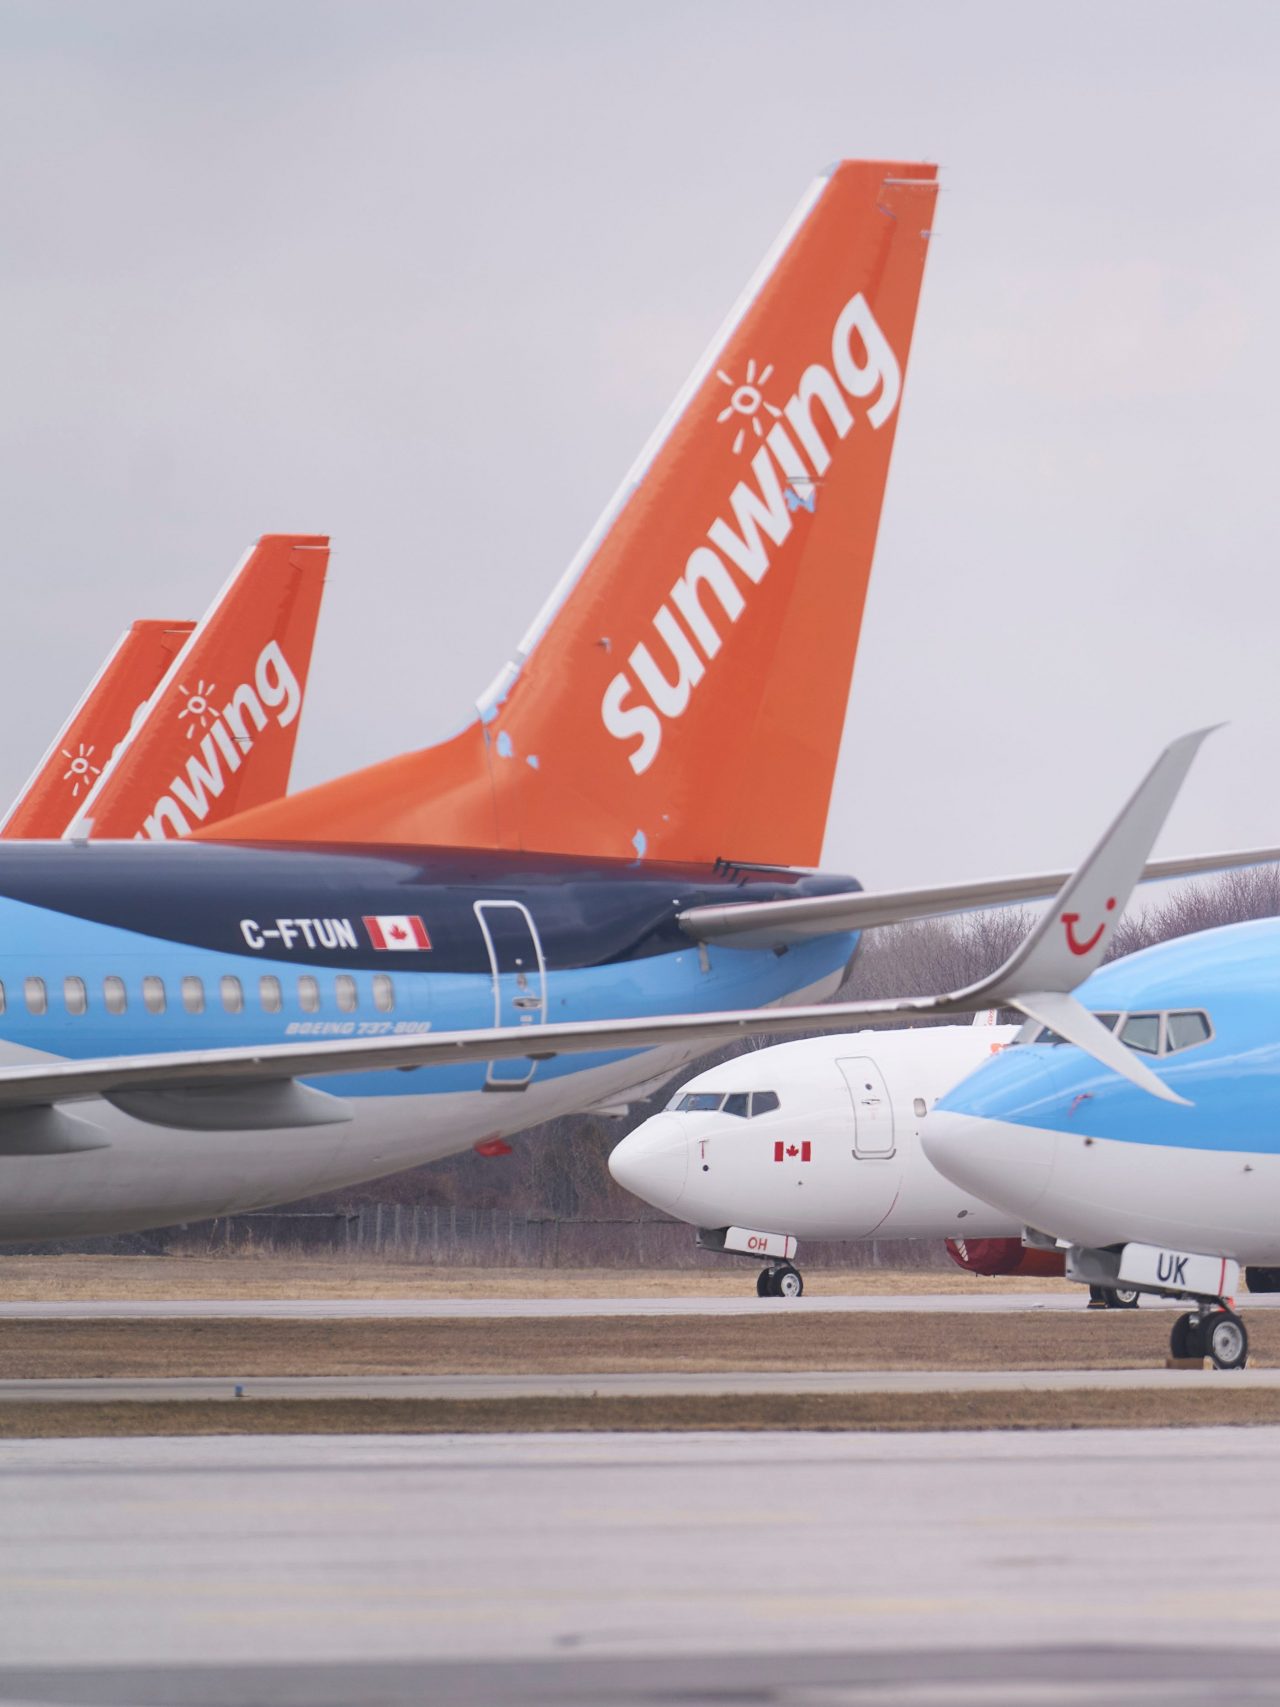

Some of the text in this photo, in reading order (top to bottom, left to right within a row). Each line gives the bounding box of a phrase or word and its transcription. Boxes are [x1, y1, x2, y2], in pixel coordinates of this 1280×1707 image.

[601, 292, 902, 775] sunwing
[133, 639, 301, 841] nwing
[239, 918, 358, 949] C-FTUN
[285, 1020, 432, 1035] BOEING 737-800
[747, 1236, 768, 1251] OH
[1157, 1252, 1189, 1285] UK
